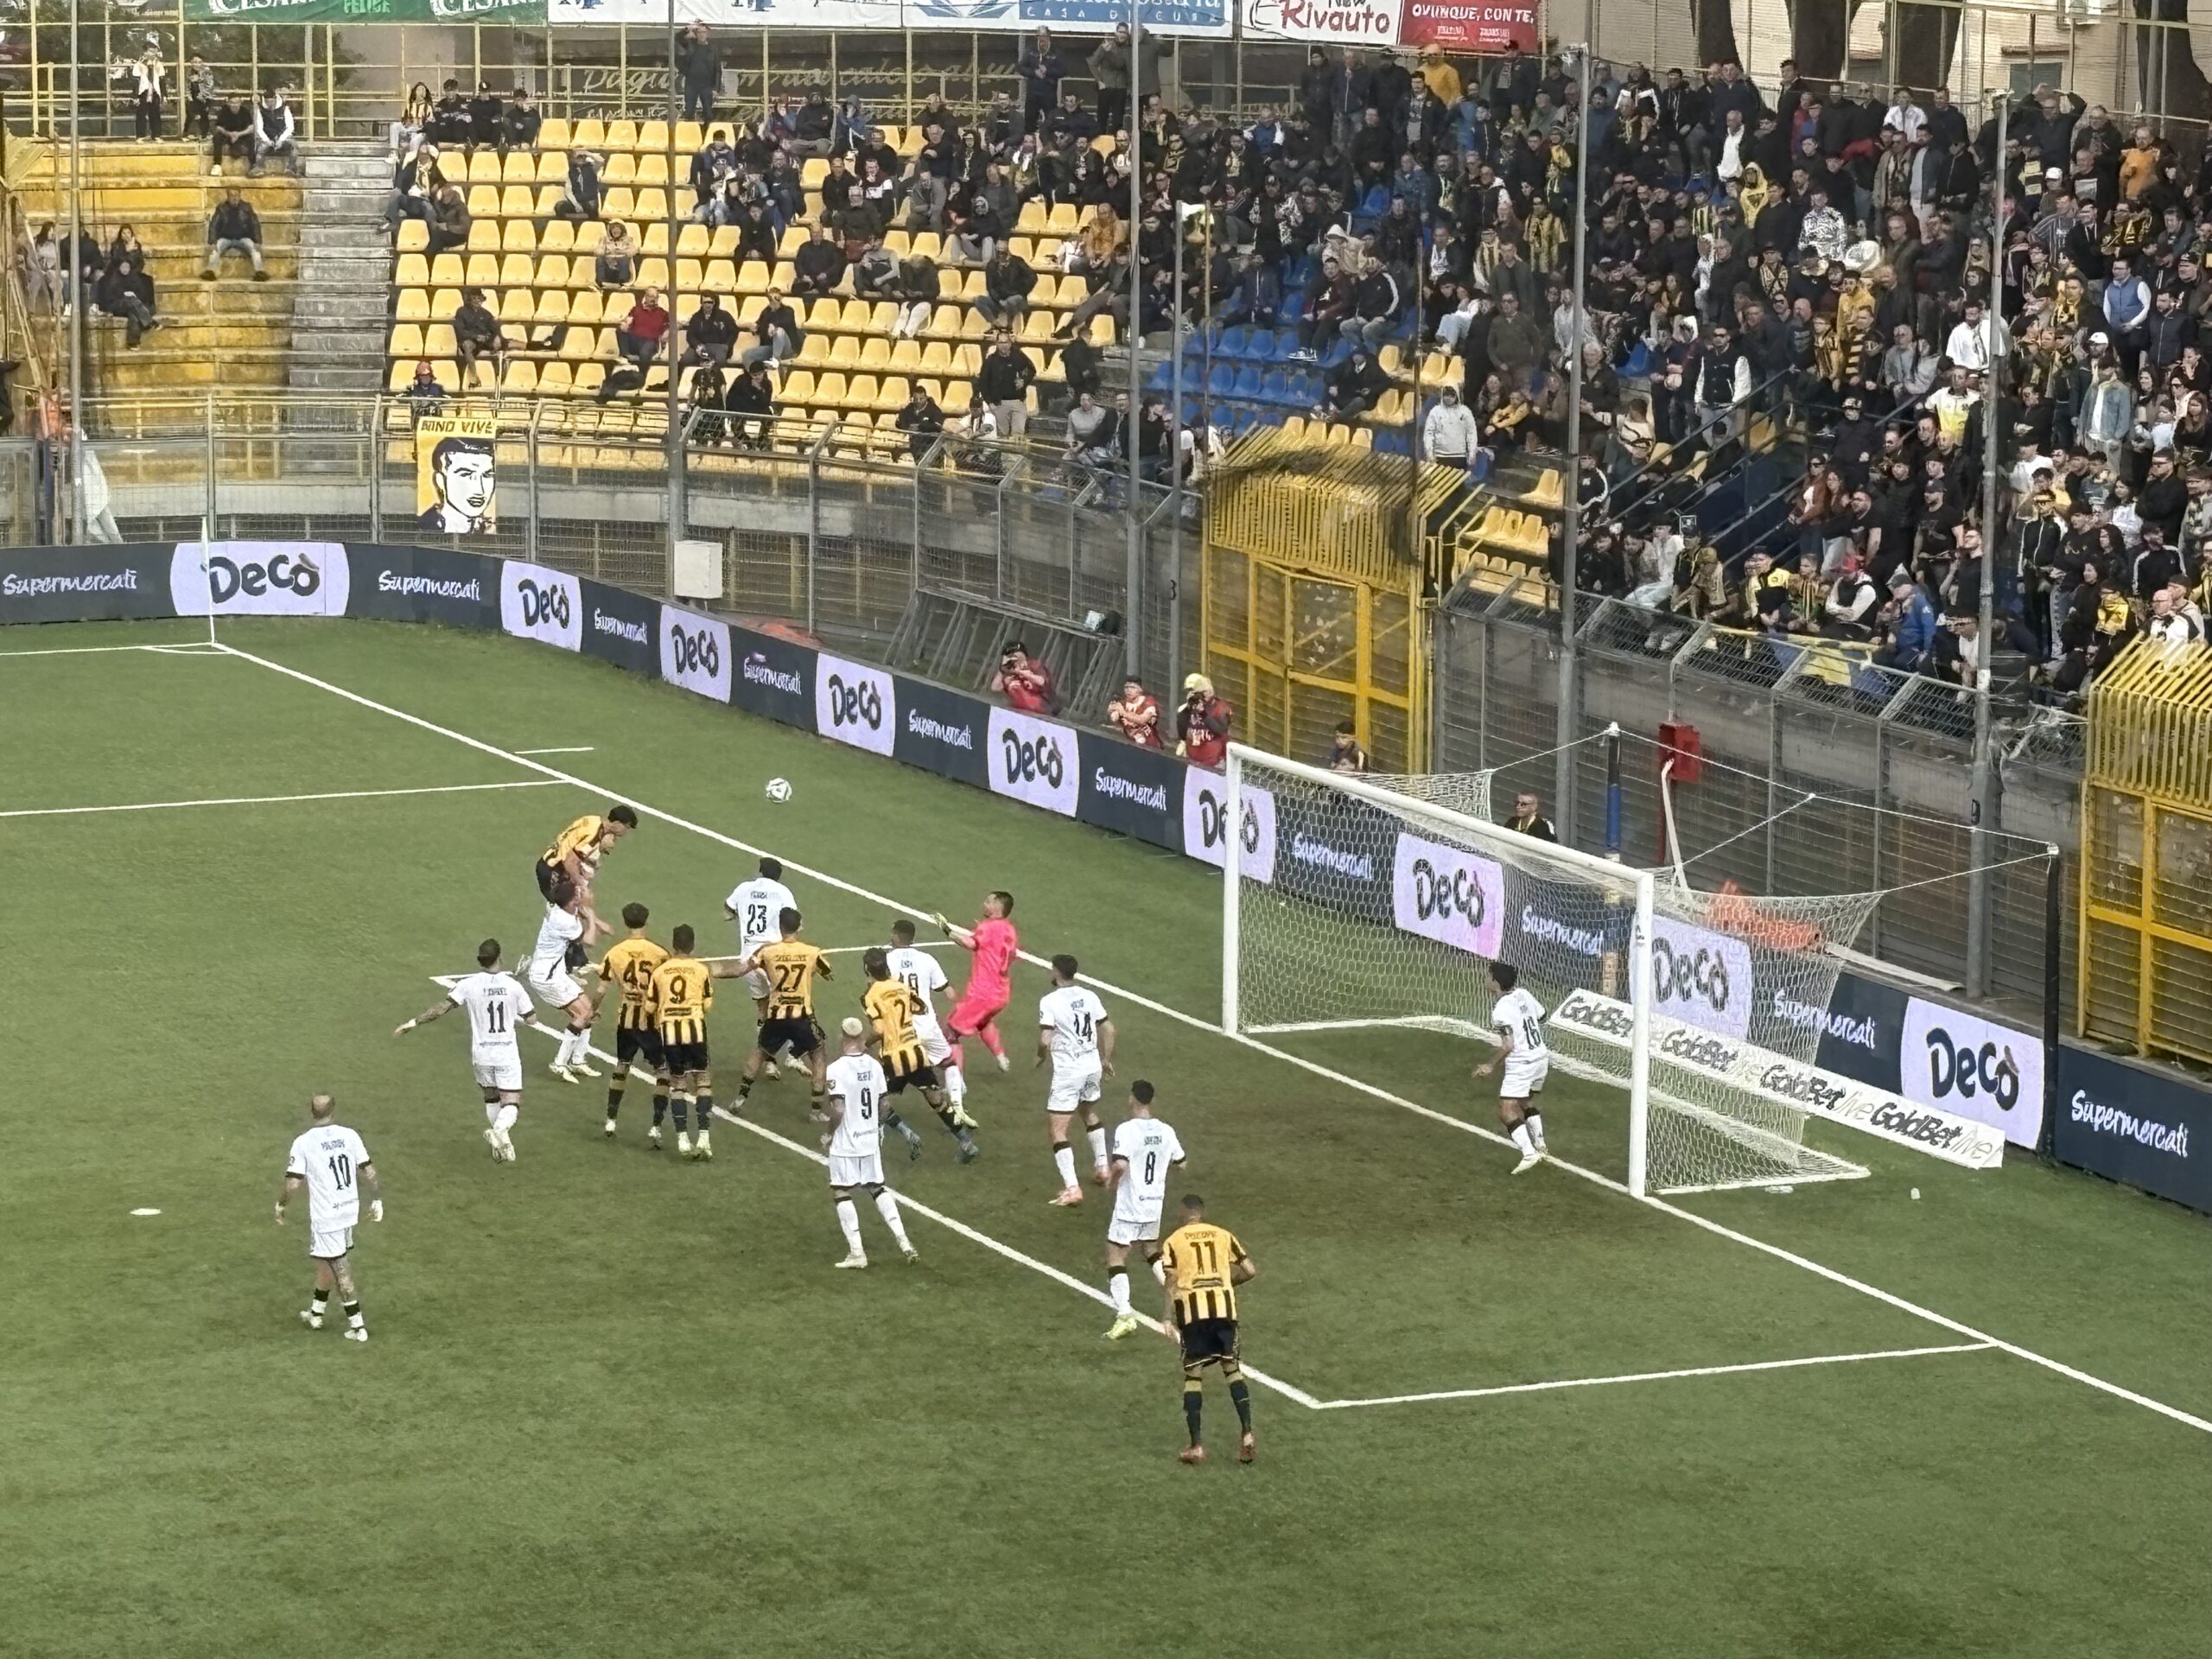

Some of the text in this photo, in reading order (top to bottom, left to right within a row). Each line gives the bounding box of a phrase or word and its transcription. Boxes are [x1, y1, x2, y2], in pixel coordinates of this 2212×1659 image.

[1276, 0, 1390, 34] Rivauto
[1484, 8, 1512, 22] CON
[3, 569, 137, 596] Supermercati
[378, 569, 480, 601] Supermercati
[909, 709, 973, 750] Supermercati
[1096, 766, 1167, 811] Supermercati
[747, 904, 766, 935] 23
[623, 958, 652, 990] 45
[670, 975, 687, 1004] 9
[775, 963, 807, 992] 27
[486, 1001, 506, 1033] 11
[1073, 1012, 1092, 1042] 14
[1560, 995, 1634, 1038] GoldBe
[1774, 990, 1876, 1049] Supermercati
[861, 1086, 872, 1120] 9
[2071, 1090, 2189, 1158] Supermercati
[328, 1154, 352, 1191] 10
[1144, 1151, 1156, 1185] 8
[1189, 1241, 1217, 1275] 11
